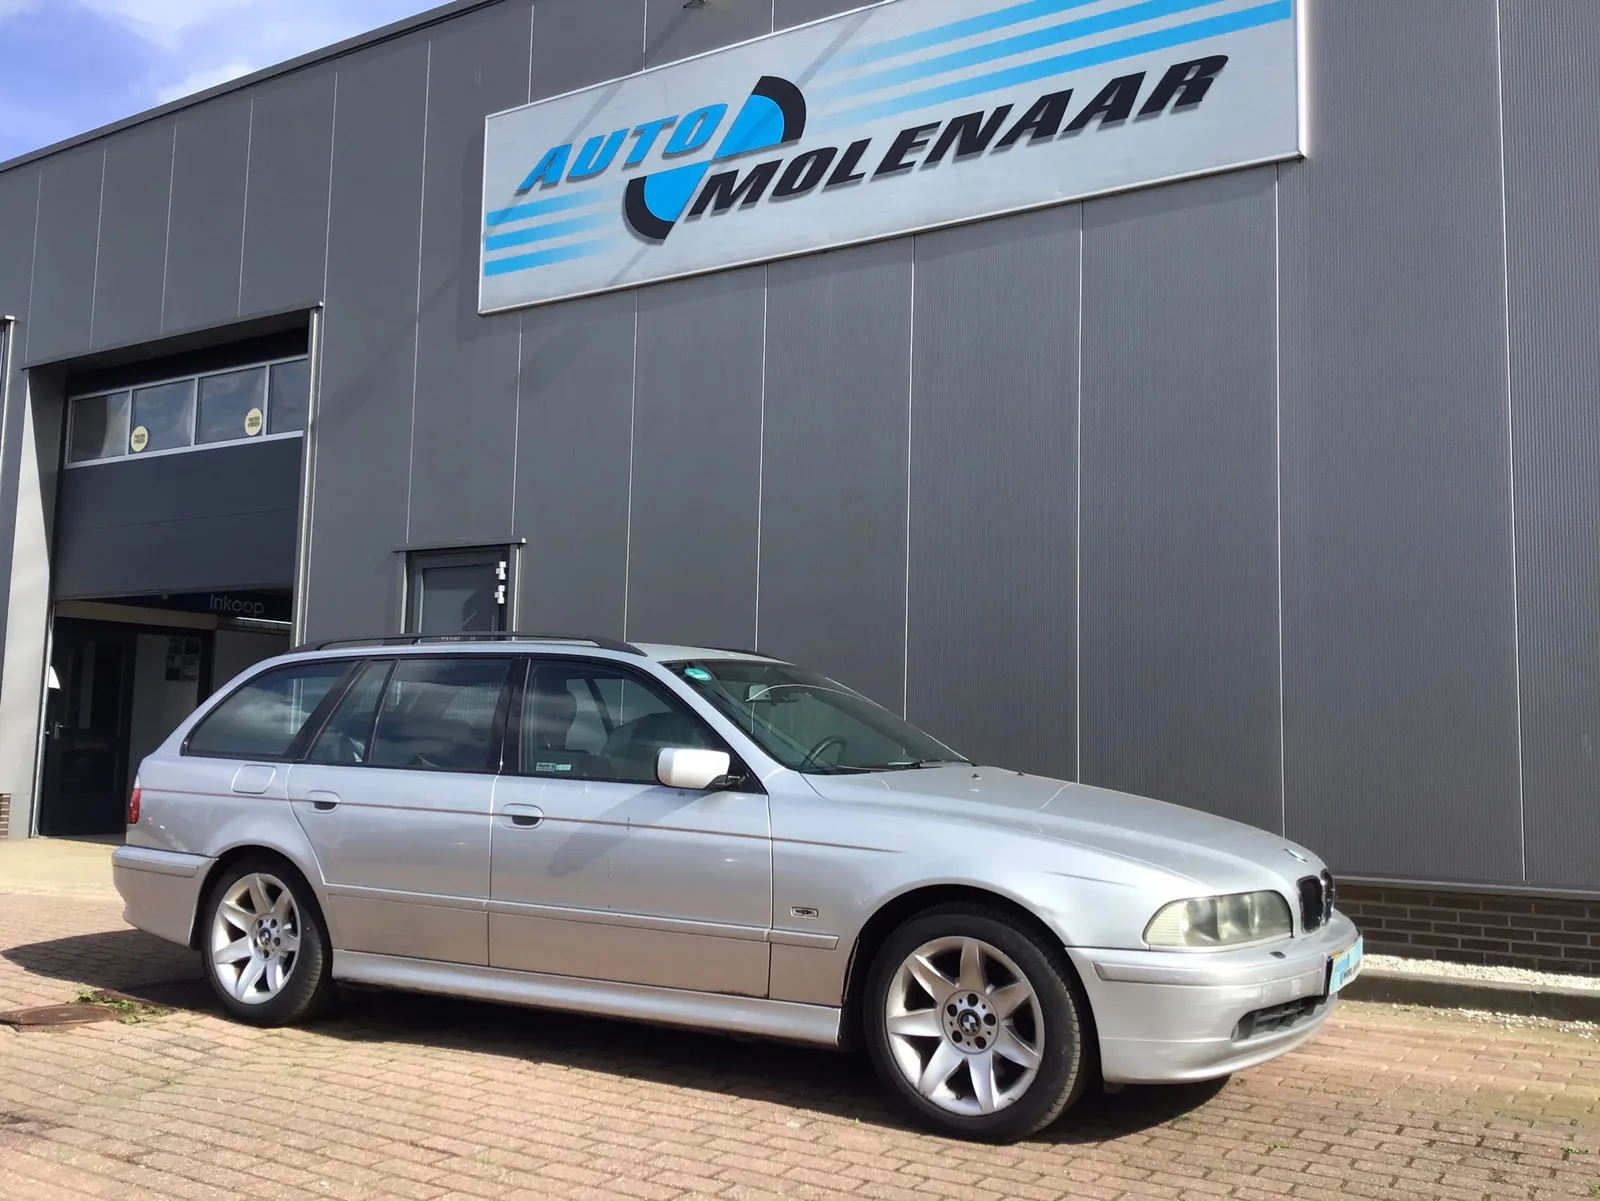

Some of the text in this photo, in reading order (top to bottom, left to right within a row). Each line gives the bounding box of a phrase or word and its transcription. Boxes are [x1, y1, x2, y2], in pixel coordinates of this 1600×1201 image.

[515, 103, 729, 193] AUTO
[687, 54, 1229, 217] MOLENAAR
[209, 593, 264, 617] Inkoop
